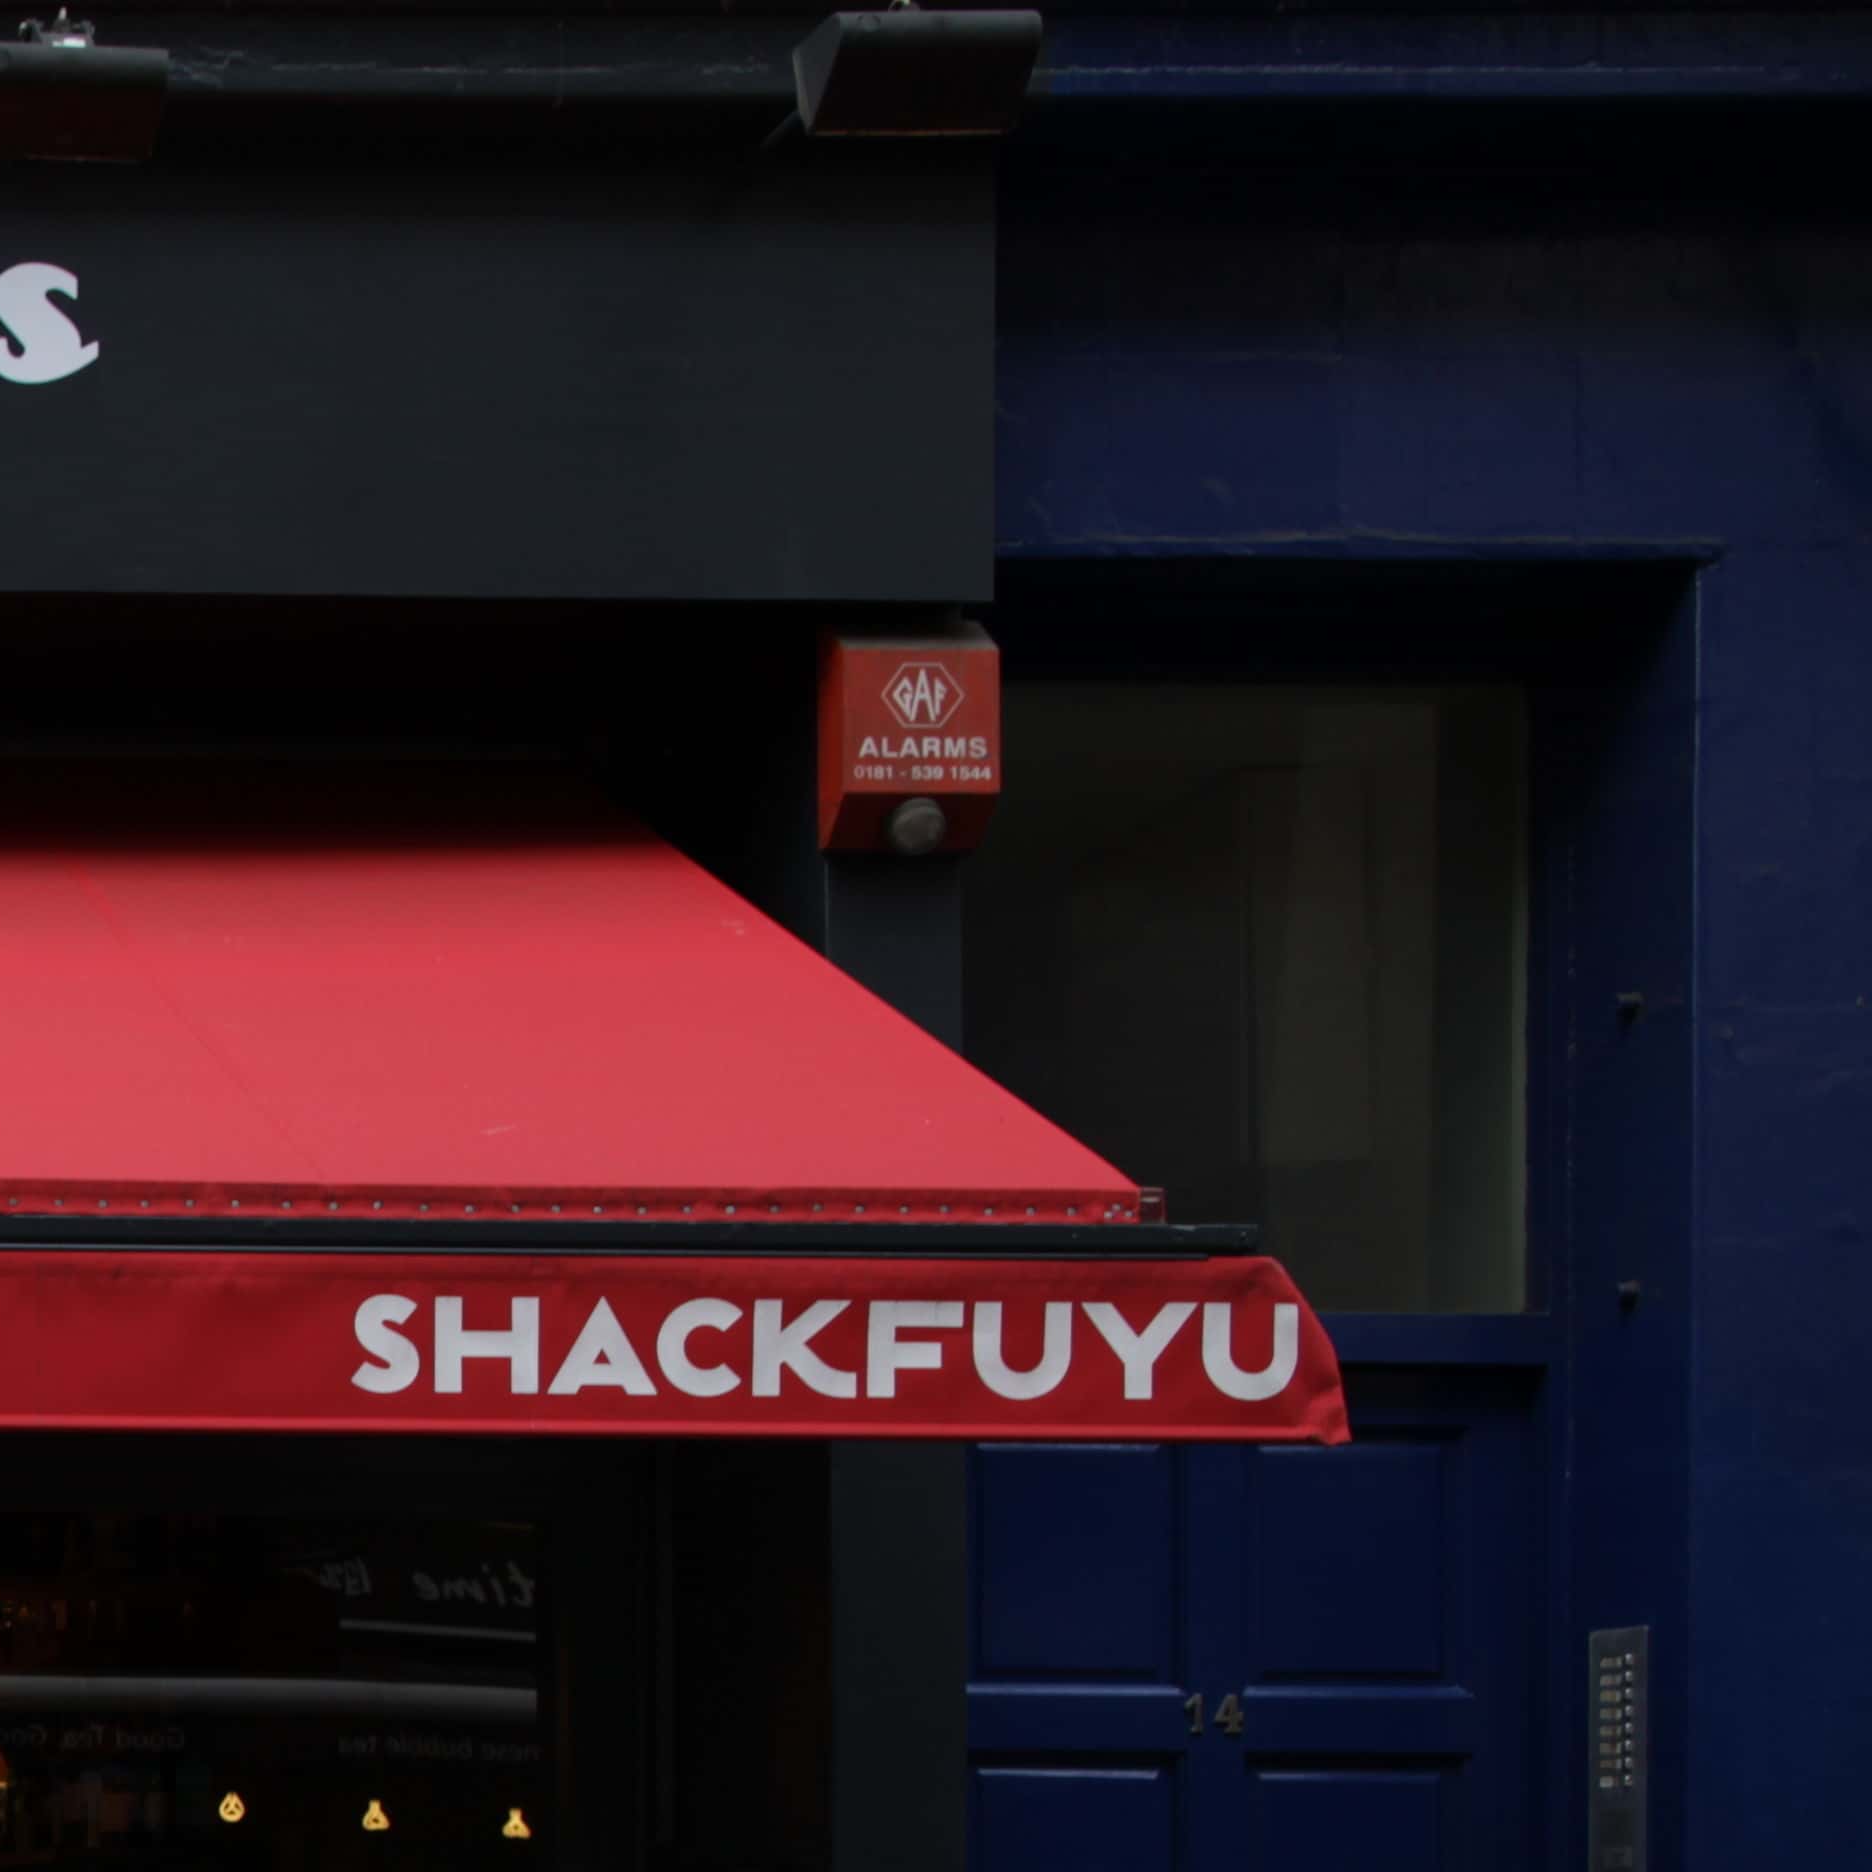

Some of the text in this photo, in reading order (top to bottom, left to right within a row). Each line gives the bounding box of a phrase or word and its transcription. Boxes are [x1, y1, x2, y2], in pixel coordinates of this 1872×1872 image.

[891, 667, 948, 722] GAF
[858, 735, 988, 758] ALARMS
[853, 765, 893, 780] 0181
[911, 765, 945, 780] 539
[950, 765, 992, 781] 1544
[350, 1293, 1300, 1402] SHACKFUYU
[1184, 1692, 1244, 1735] 14
